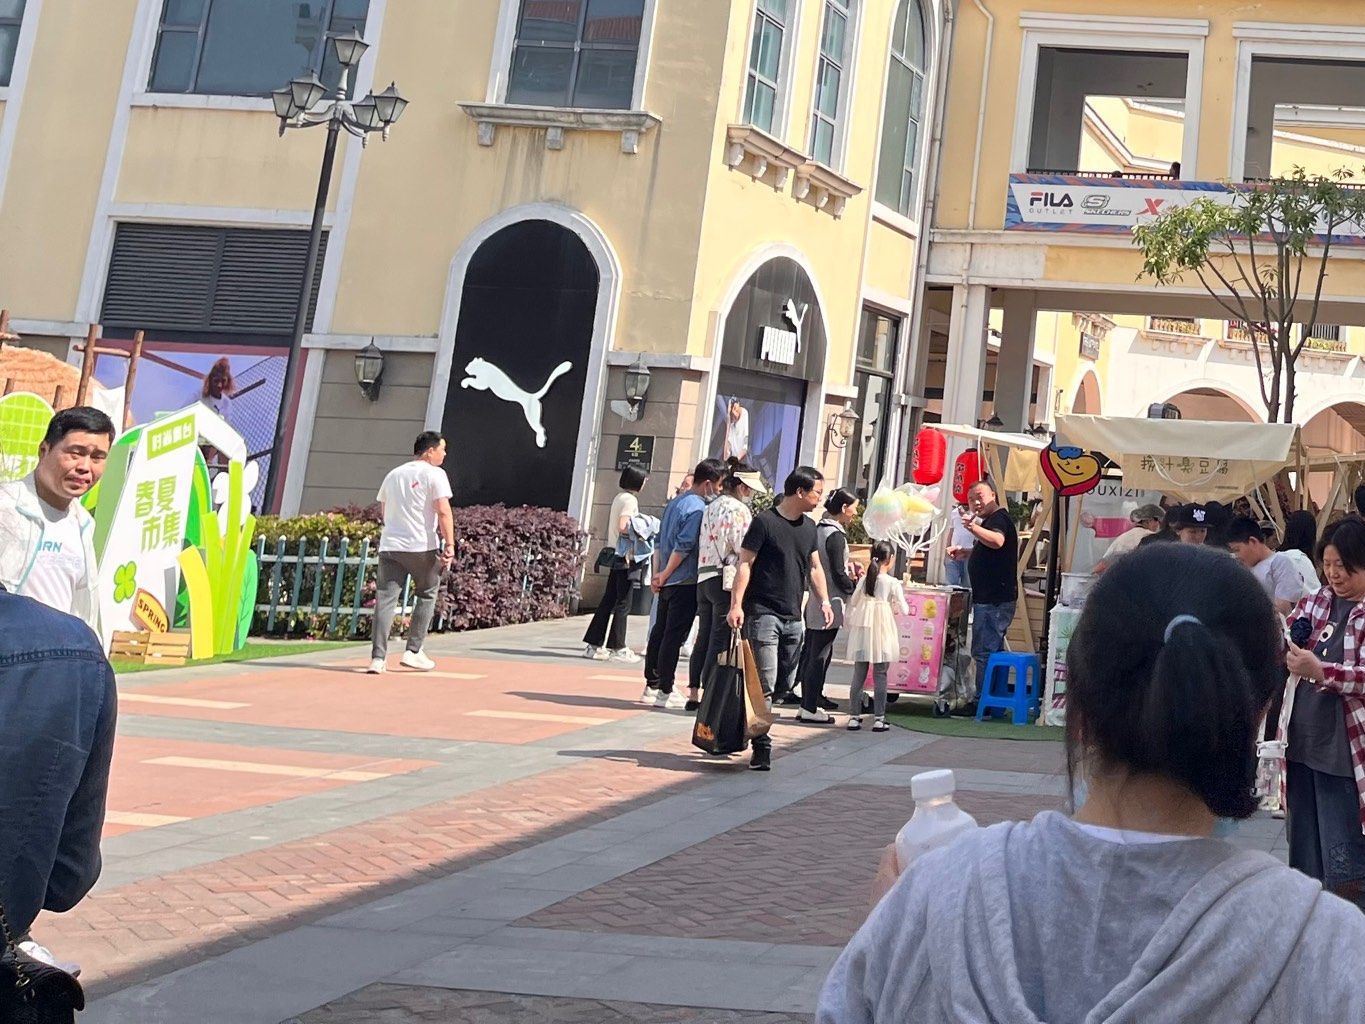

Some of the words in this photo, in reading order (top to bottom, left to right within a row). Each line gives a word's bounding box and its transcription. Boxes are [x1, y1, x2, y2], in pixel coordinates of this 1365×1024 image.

[1029, 191, 1073, 207] FILA
[1083, 208, 1131, 217] SKECHERS
[134, 475, 177, 518] 春夏
[141, 510, 181, 553] 市集
